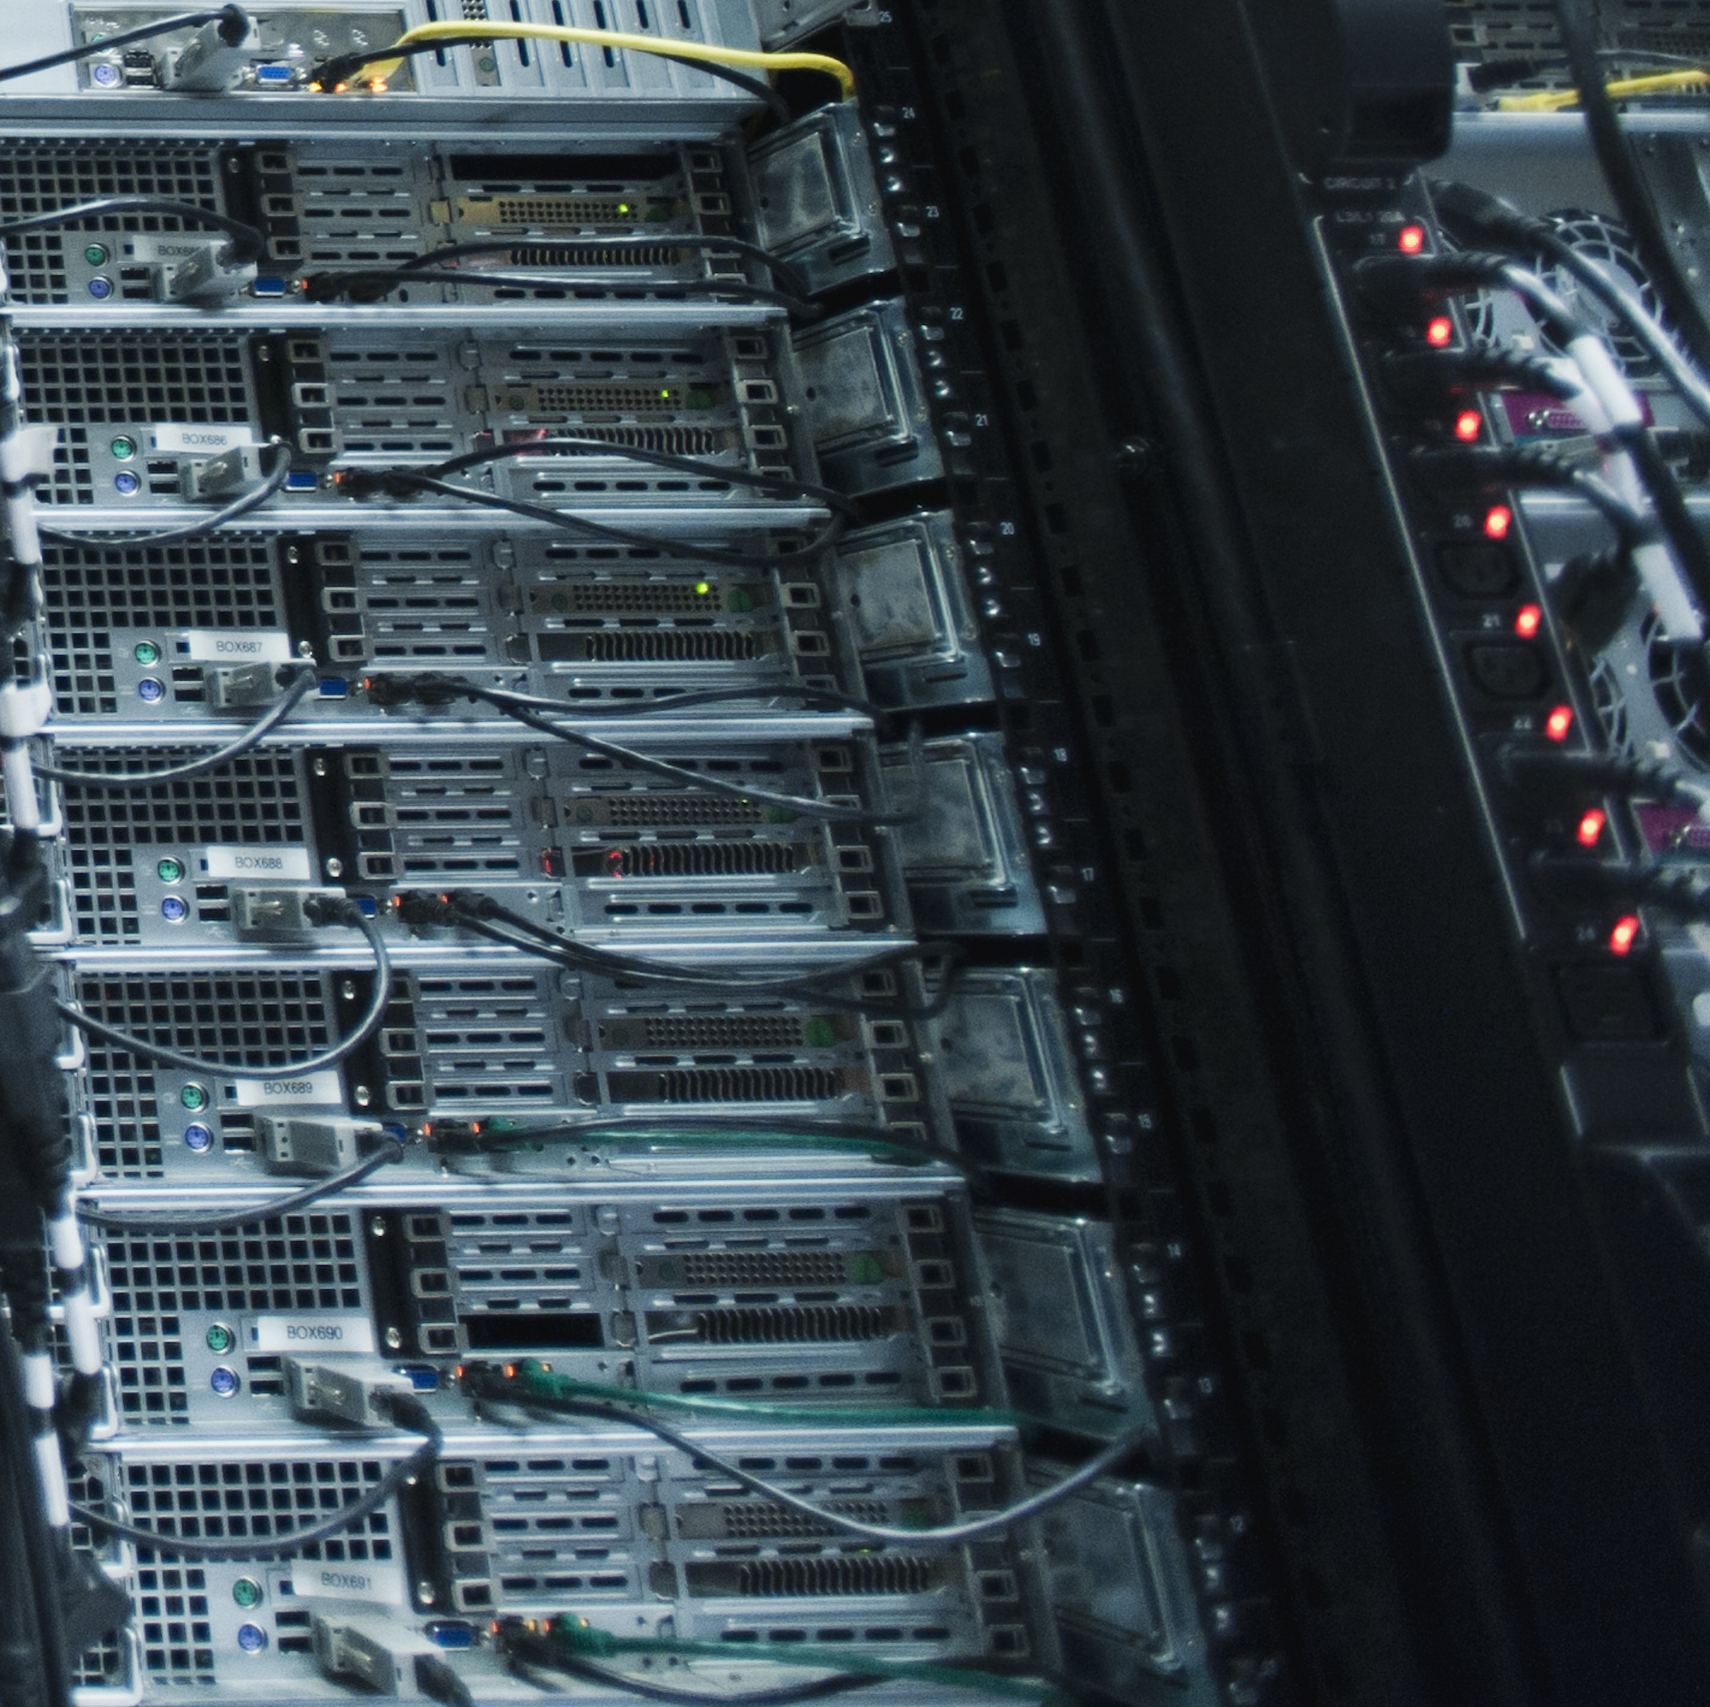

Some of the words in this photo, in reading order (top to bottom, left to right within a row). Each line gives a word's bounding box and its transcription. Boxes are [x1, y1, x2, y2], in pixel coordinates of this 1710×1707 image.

[902, 107, 916, 119] 24
[925, 205, 940, 218] 23
[949, 306, 964, 321] 22
[974, 413, 989, 427] 21
[1000, 521, 1015, 536] 20
[215, 639, 263, 653] BOX687
[263, 1081, 313, 1095] BOX689
[286, 1324, 344, 1340] BOX690
[320, 1571, 373, 1591] BOX691
